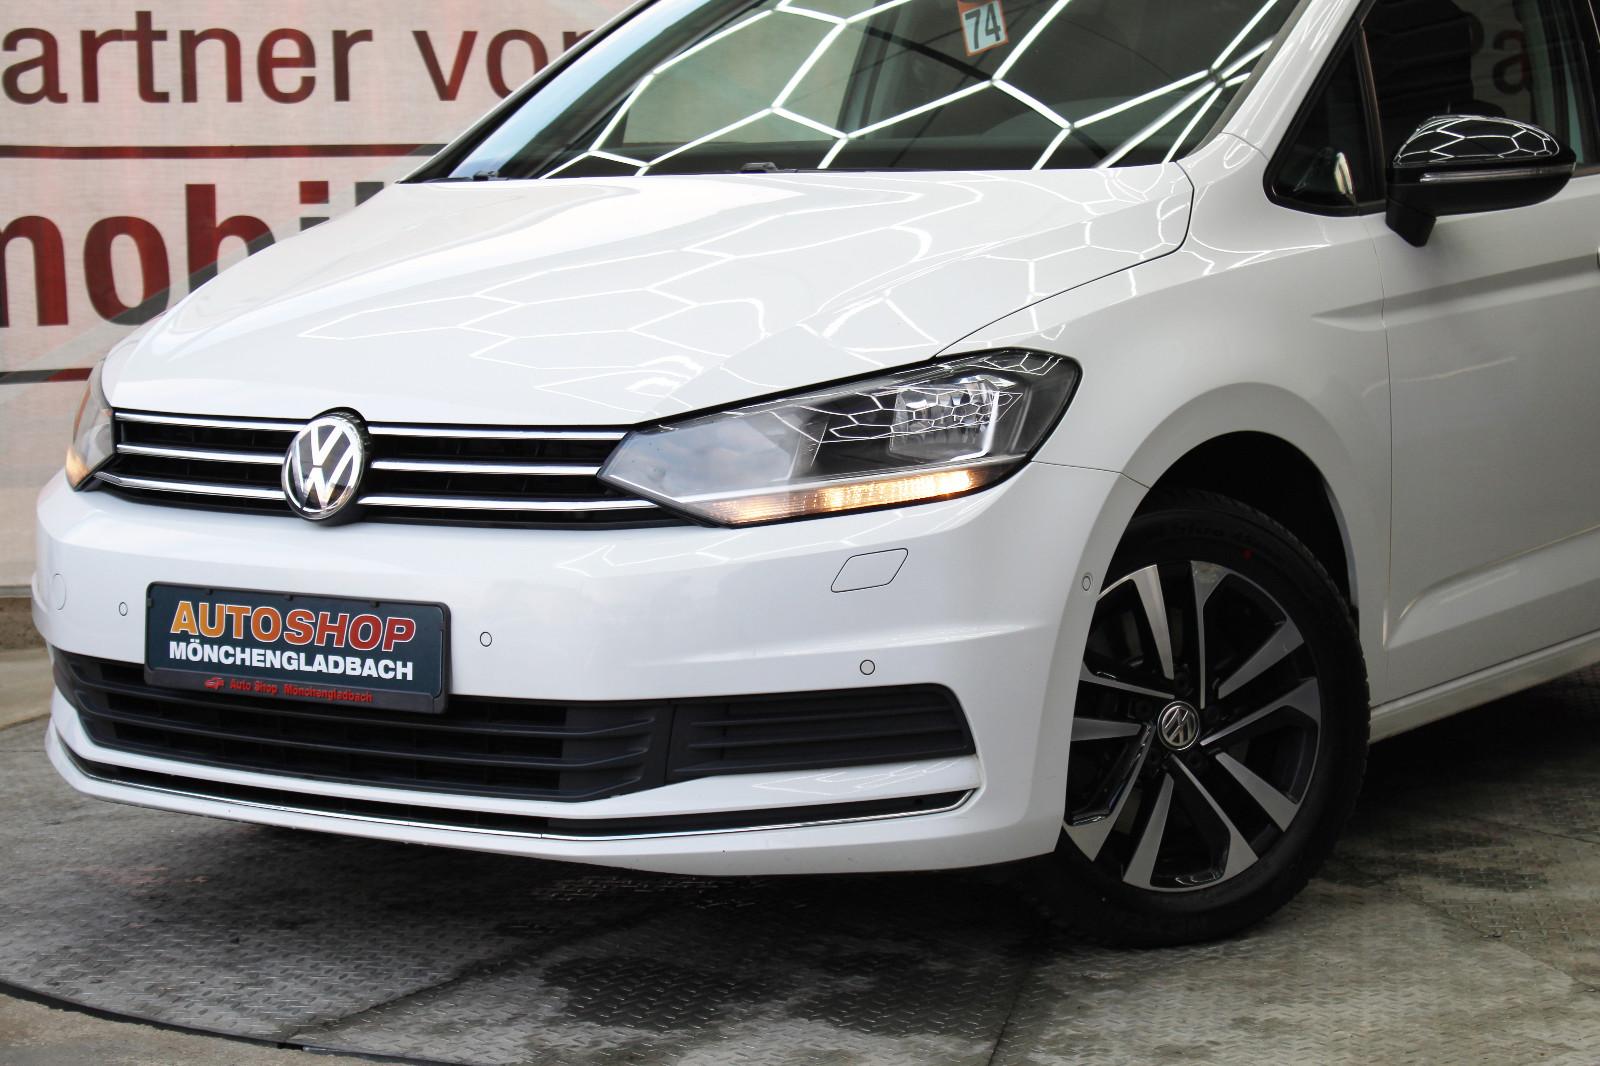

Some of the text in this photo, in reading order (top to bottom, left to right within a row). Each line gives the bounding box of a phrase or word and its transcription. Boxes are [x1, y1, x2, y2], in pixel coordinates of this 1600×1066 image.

[965, 3, 1001, 50] 74
[411, 29, 597, 102] vo
[170, 600, 416, 652] AUTOSHOP
[169, 639, 413, 681] MÖNCHENGLADBACH
[229, 679, 252, 692] Auto
[254, 680, 278, 697] Shop
